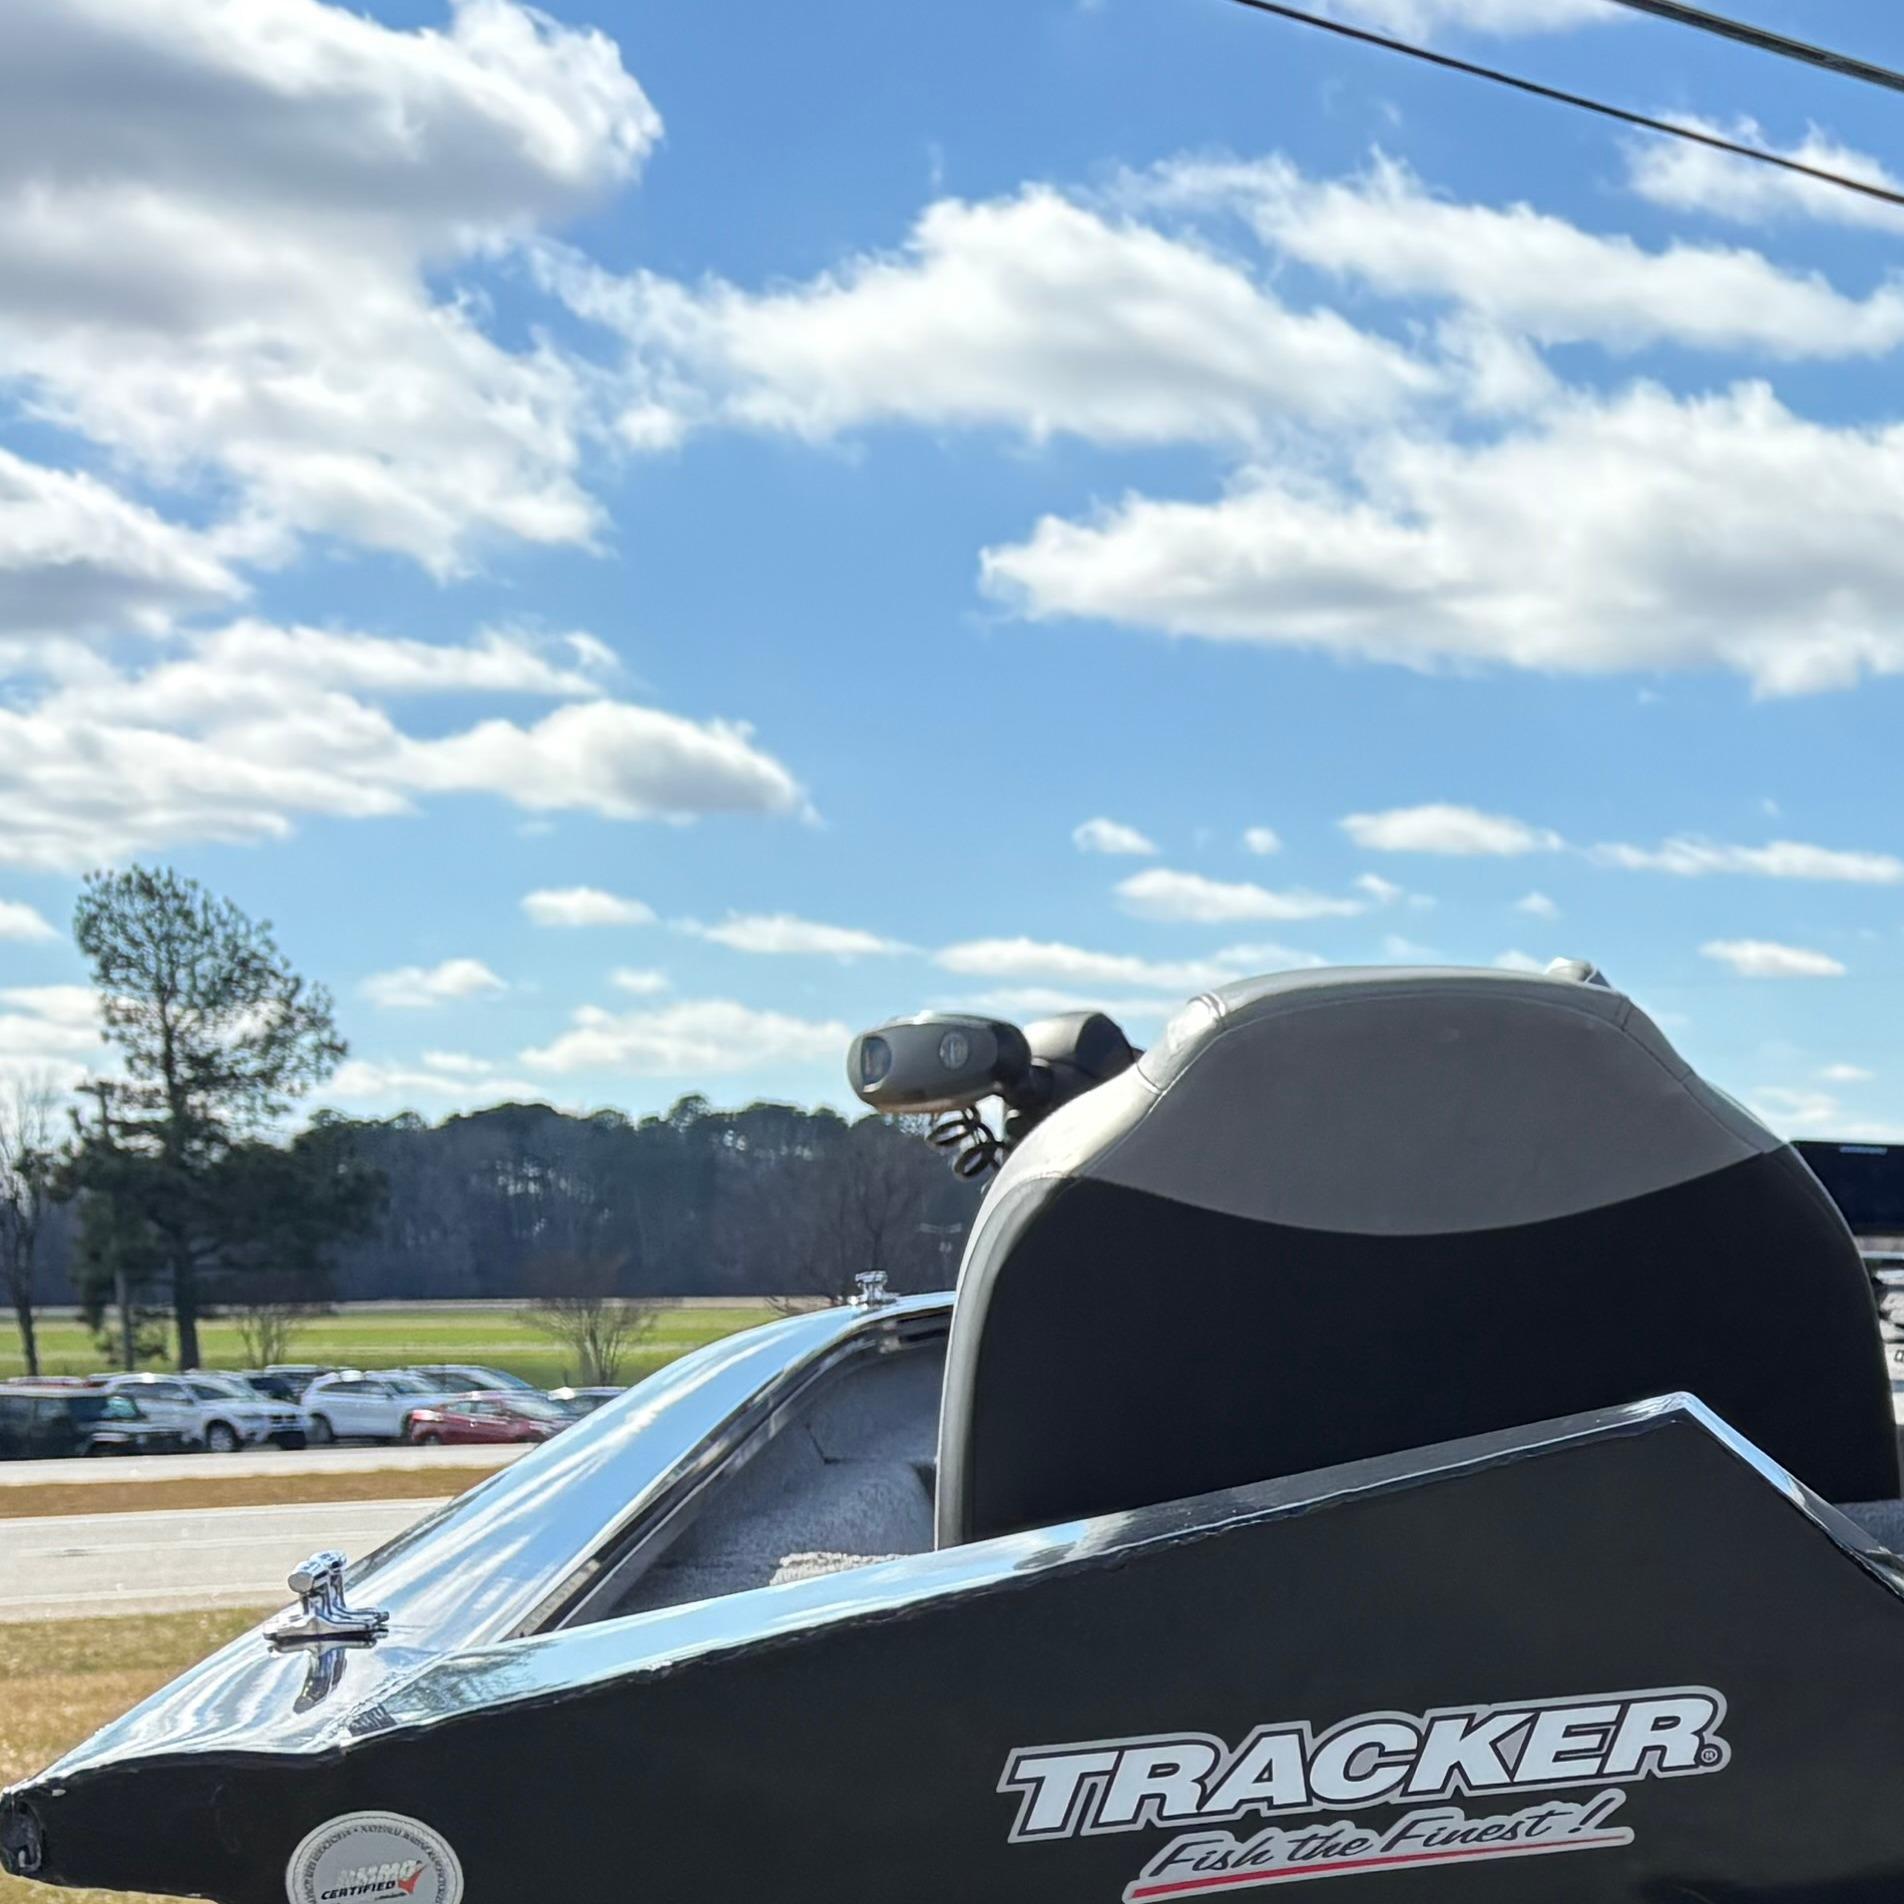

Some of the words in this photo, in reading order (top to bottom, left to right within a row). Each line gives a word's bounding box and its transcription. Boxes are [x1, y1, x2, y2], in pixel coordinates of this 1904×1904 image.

[1000, 1690, 1722, 1837] TRACKER
[1149, 1832, 1273, 1878] Fish
[1279, 1825, 1368, 1864] the
[320, 1879, 396, 1900] CERTIFIED
